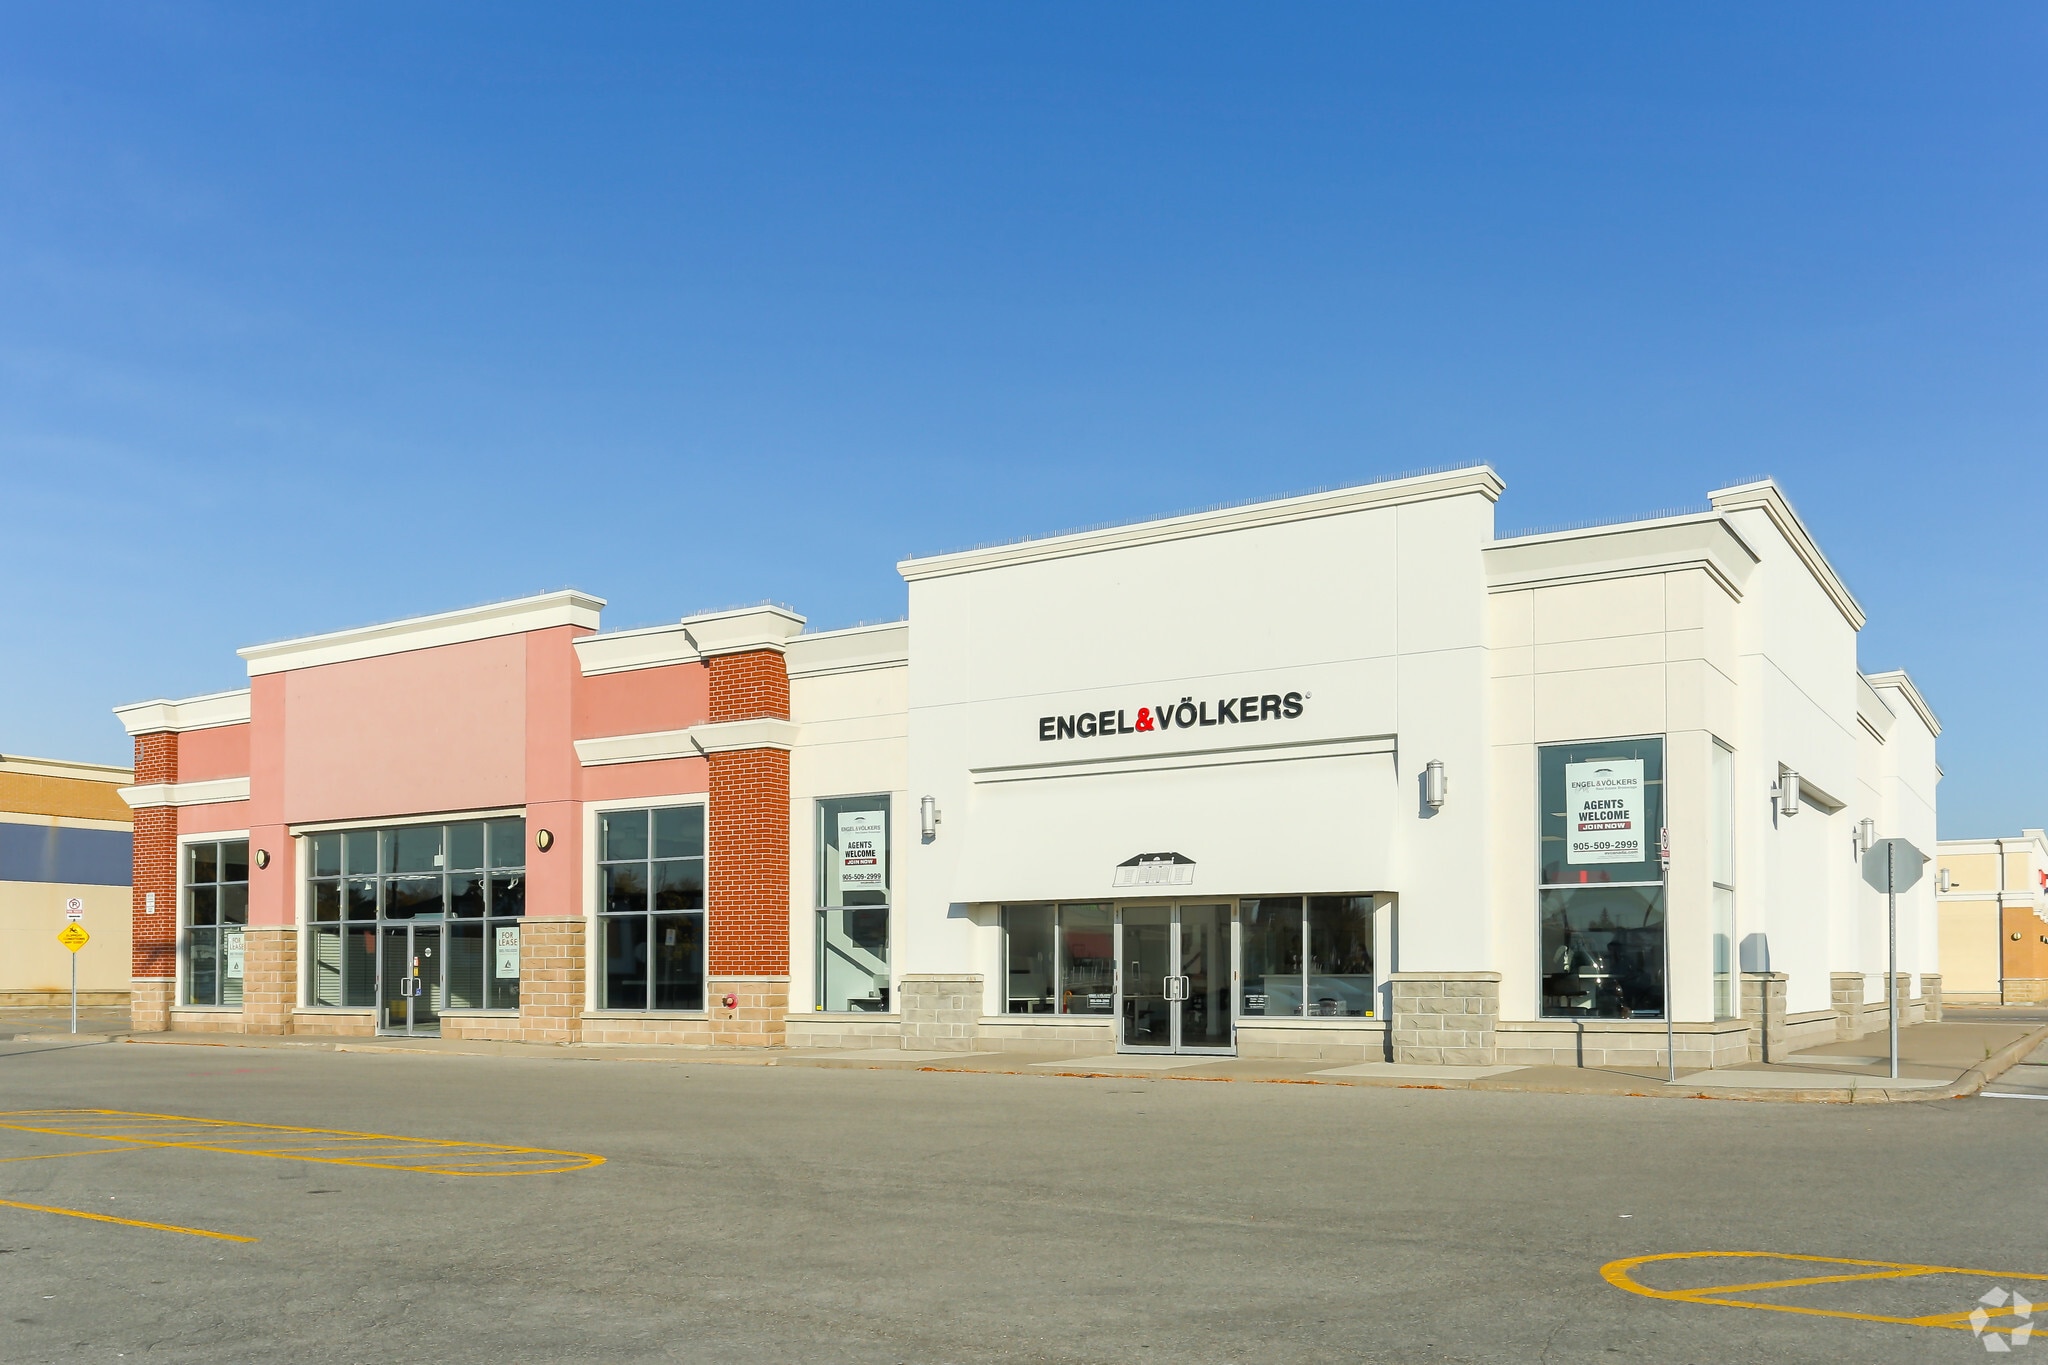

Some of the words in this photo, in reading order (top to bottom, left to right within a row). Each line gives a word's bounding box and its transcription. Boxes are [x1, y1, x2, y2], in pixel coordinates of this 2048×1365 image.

[1039, 691, 1304, 741] ENGEL&VÖLKERS
[1583, 799, 1624, 810] AGENTS
[1579, 810, 1630, 821] WELCOME
[847, 841, 872, 849] AGENTS
[1573, 840, 1638, 850] 905-509-2999
[845, 850, 876, 858] WELCOME
[501, 931, 514, 939] FOR
